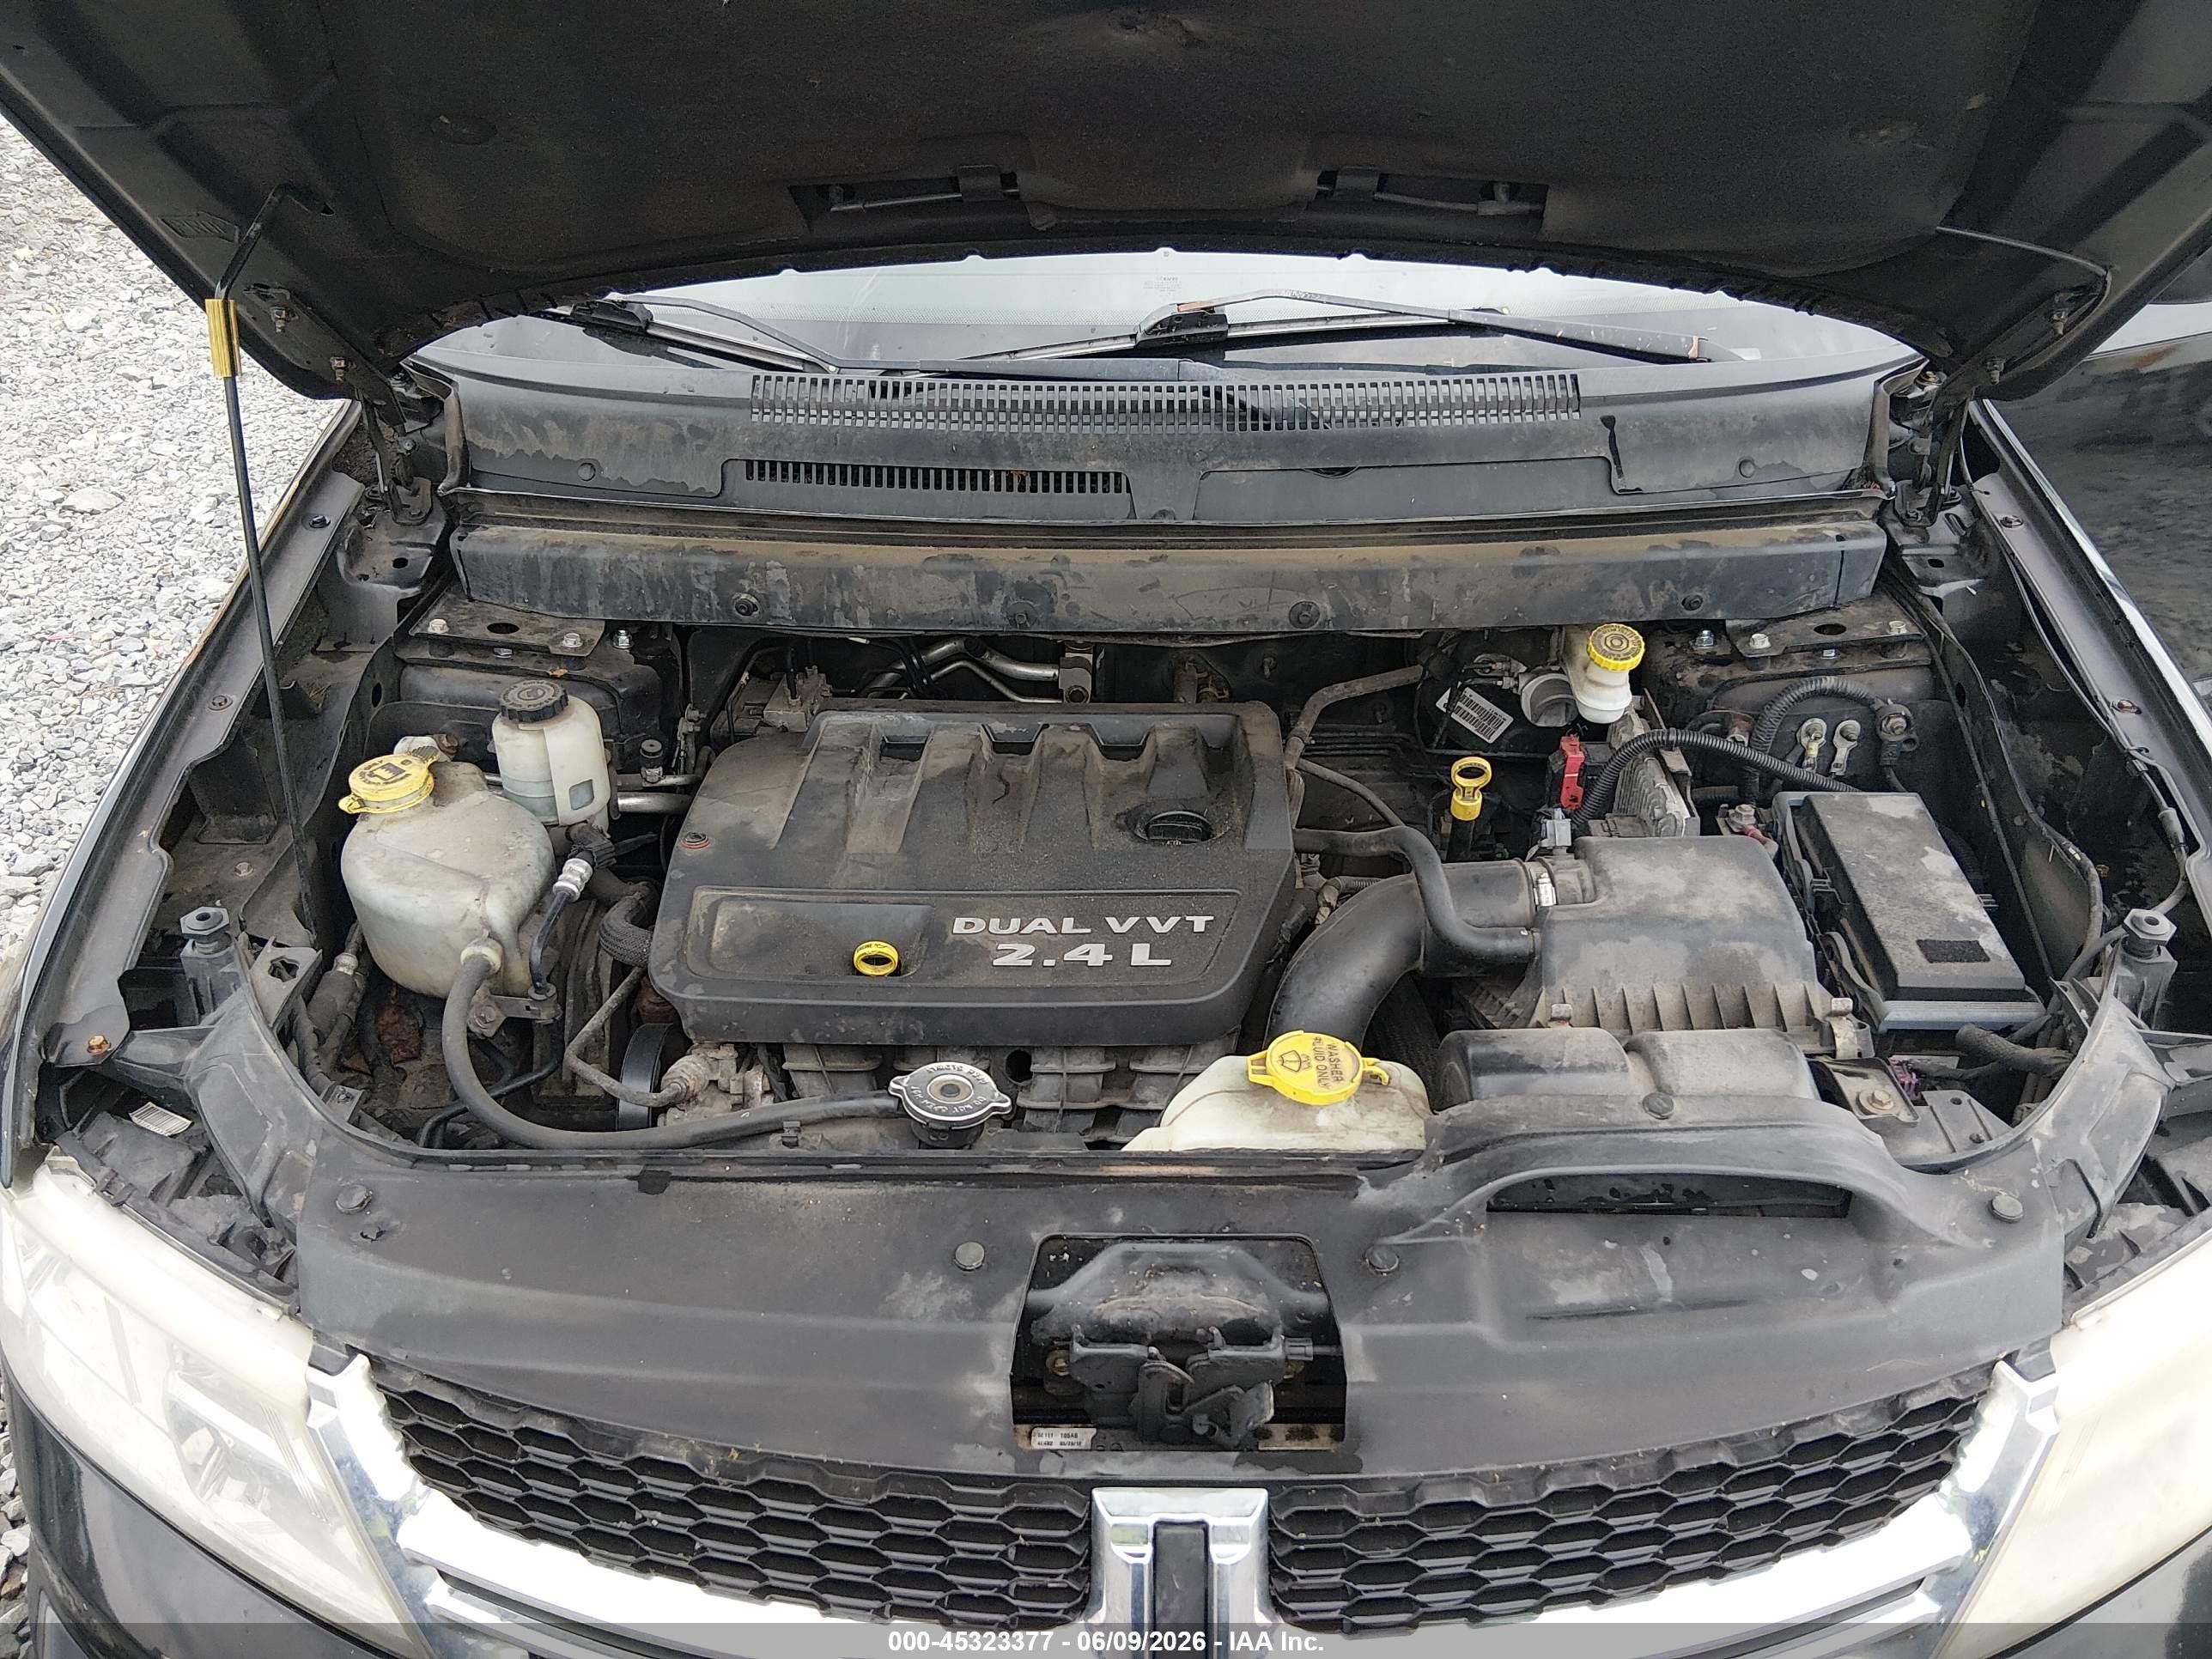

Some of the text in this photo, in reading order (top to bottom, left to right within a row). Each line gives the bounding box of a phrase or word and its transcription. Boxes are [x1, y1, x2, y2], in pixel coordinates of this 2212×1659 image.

[951, 915, 1215, 935] DUAL VVT
[992, 943, 1173, 967] 2.4 L
[1312, 1036, 1331, 1090] FLUID ONLY
[1327, 1042, 1344, 1083] WASHER
